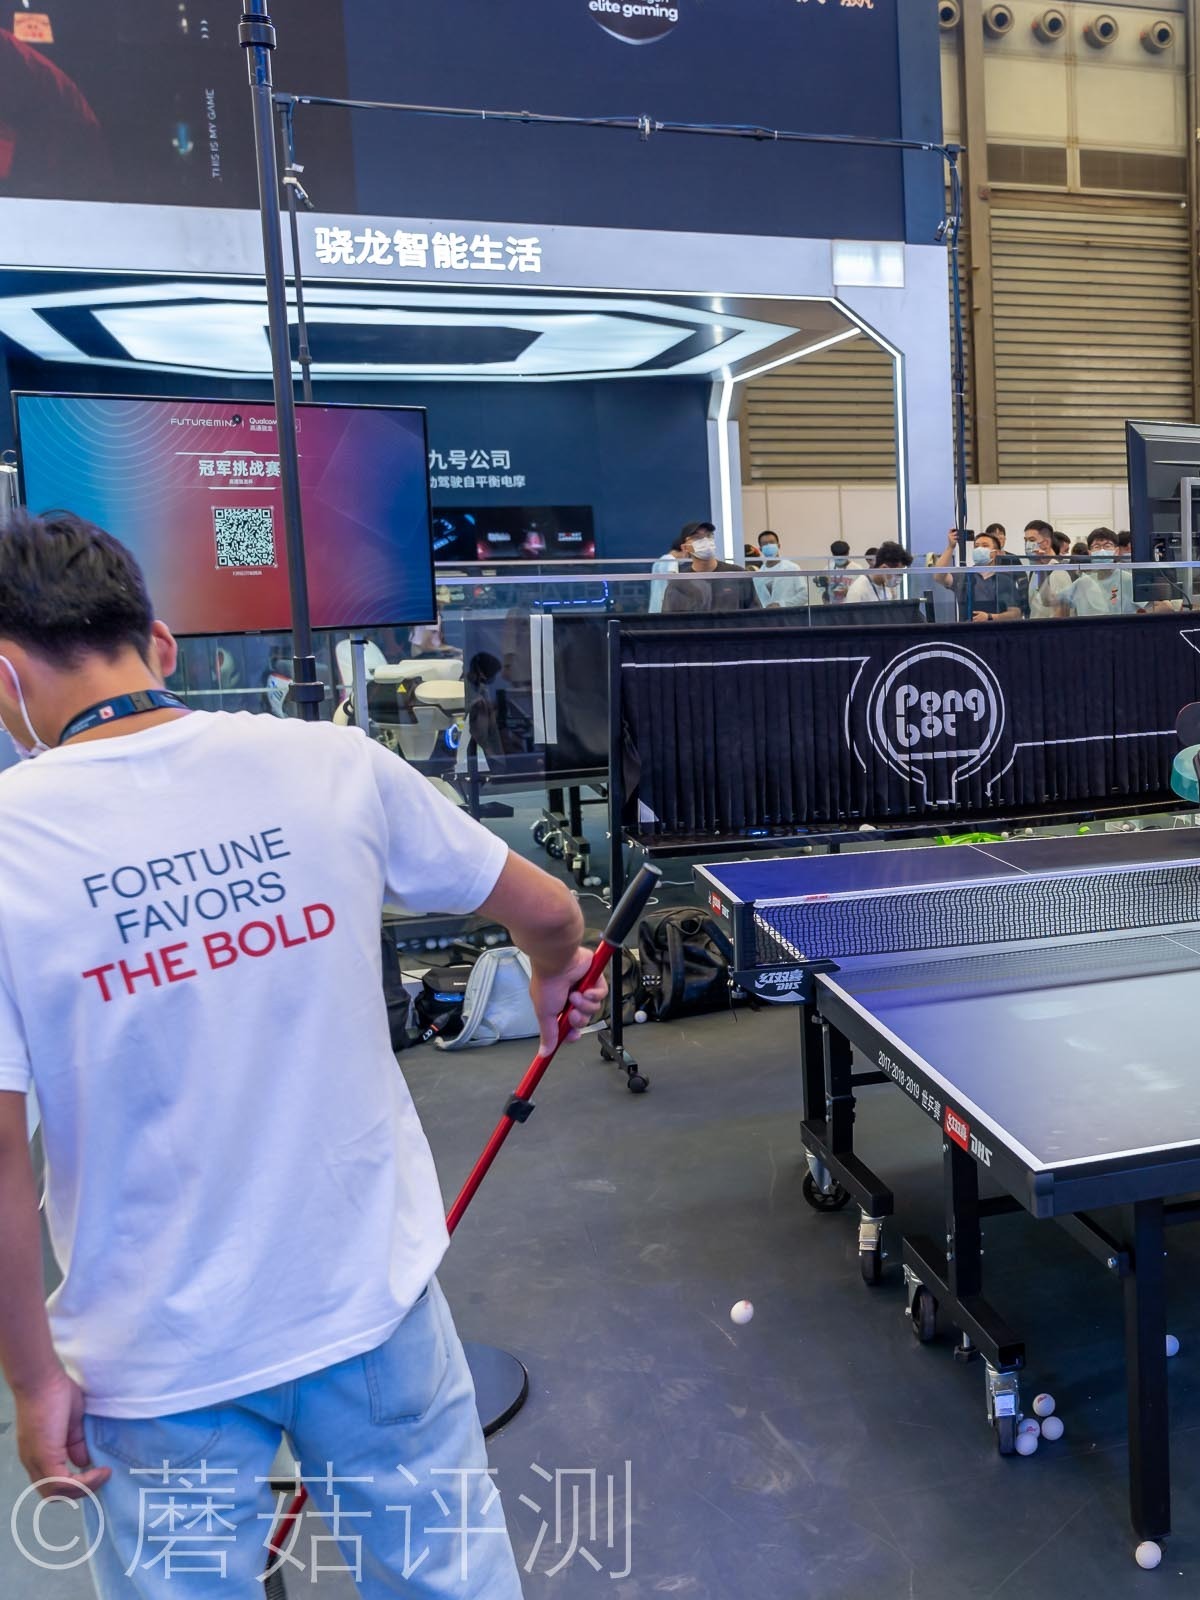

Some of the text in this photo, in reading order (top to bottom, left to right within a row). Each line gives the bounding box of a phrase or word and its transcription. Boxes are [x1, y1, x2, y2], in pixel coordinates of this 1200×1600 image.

[589, 0, 678, 22] elite gaming
[205, 88, 217, 120] GAME
[314, 226, 542, 273] 骁龙智能生活
[199, 459, 281, 478] 冠军挑战赛
[428, 449, 511, 470] 九号公司
[82, 827, 291, 908] FORTUNE
[114, 871, 286, 944] FAVORS
[81, 903, 336, 1002] THE BOLD
[776, 981, 802, 991] DHS
[878, 1050, 941, 1121] 2017-2018-2019 世乒赛
[970, 1132, 993, 1168] DHS
